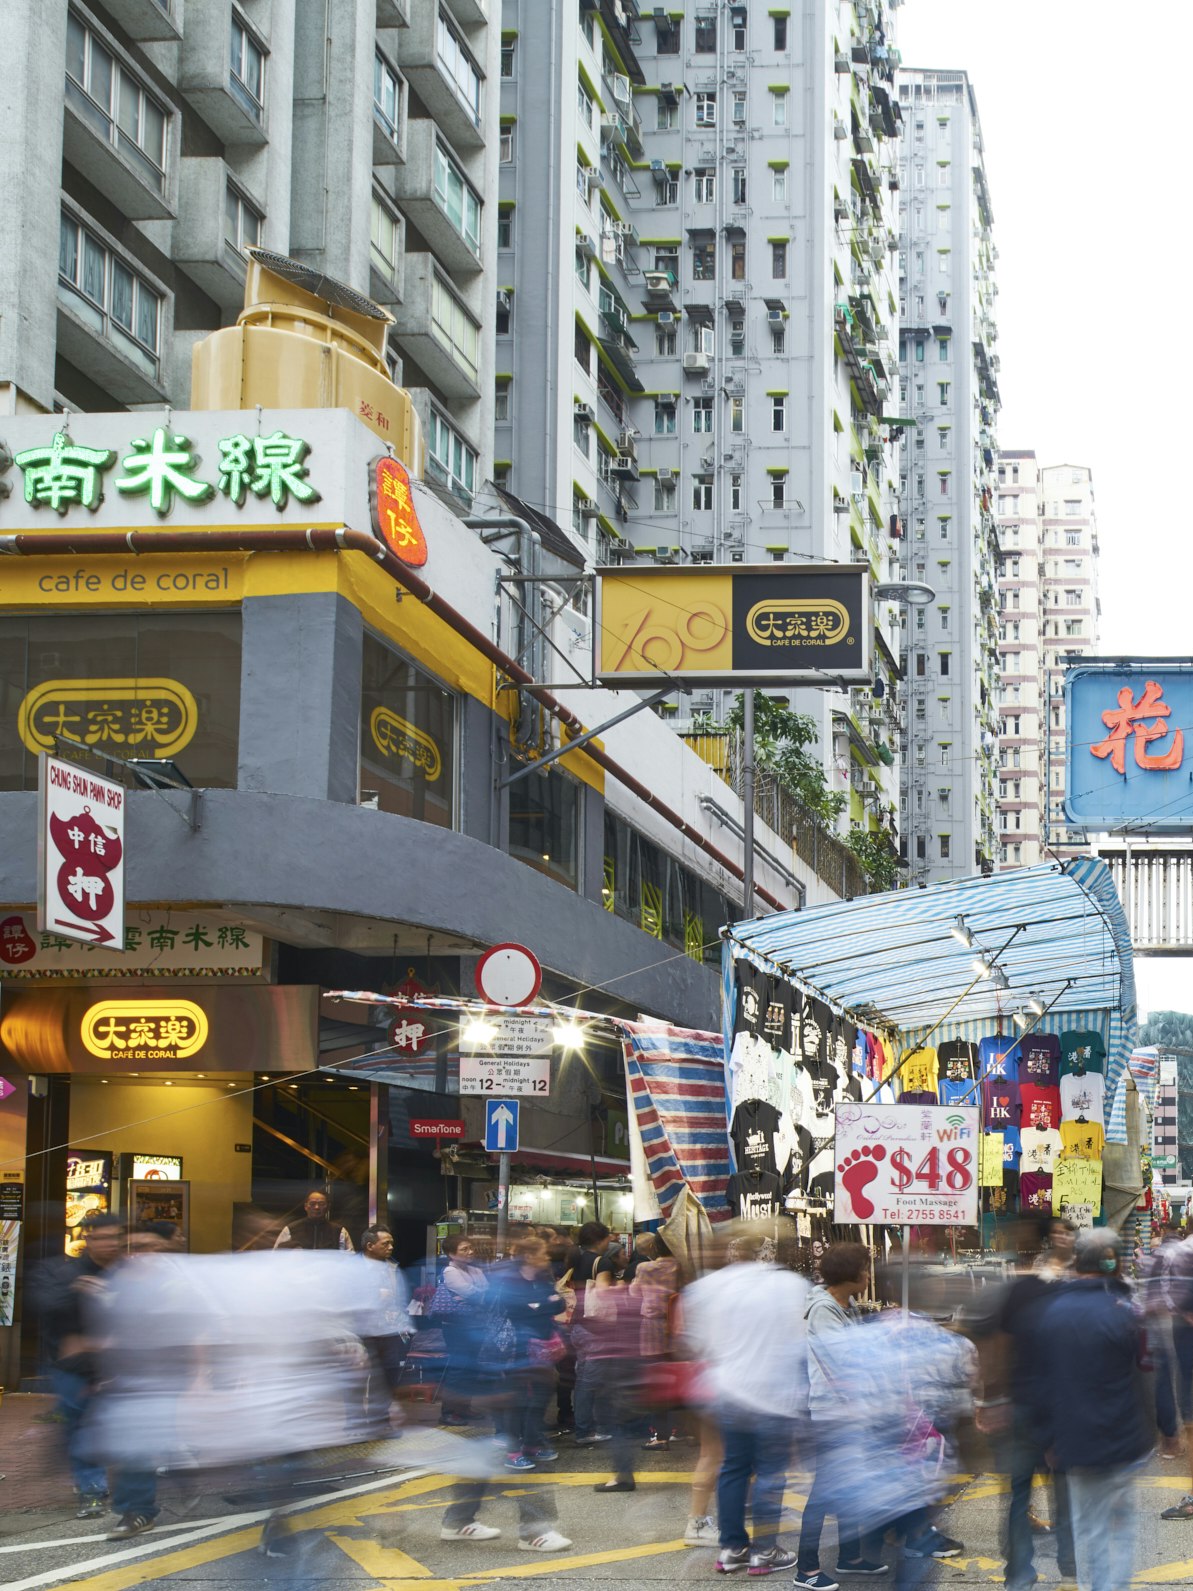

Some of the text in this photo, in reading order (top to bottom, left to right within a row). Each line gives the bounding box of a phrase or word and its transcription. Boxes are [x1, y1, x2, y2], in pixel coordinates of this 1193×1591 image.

[0, 427, 322, 513] 南米線
[38, 567, 229, 592] cafe de coral
[51, 765, 122, 811] CHUNG SHUN PAWN SHOP
[67, 826, 106, 856] 中信
[67, 867, 105, 911] 押
[40, 924, 250, 952] 譚雲南米線
[394, 1019, 425, 1051] 押
[135, 1051, 146, 1059] DE
[147, 1050, 176, 1059] CORAL
[986, 1063, 1007, 1075] HK
[479, 1078, 494, 1090] 12
[532, 1079, 547, 1092] 12
[990, 1107, 1011, 1118] HK
[890, 1146, 973, 1194] $48
[882, 1208, 966, 1220] Tel: 2755 8541
[896, 1198, 959, 1207] Foot Massage
